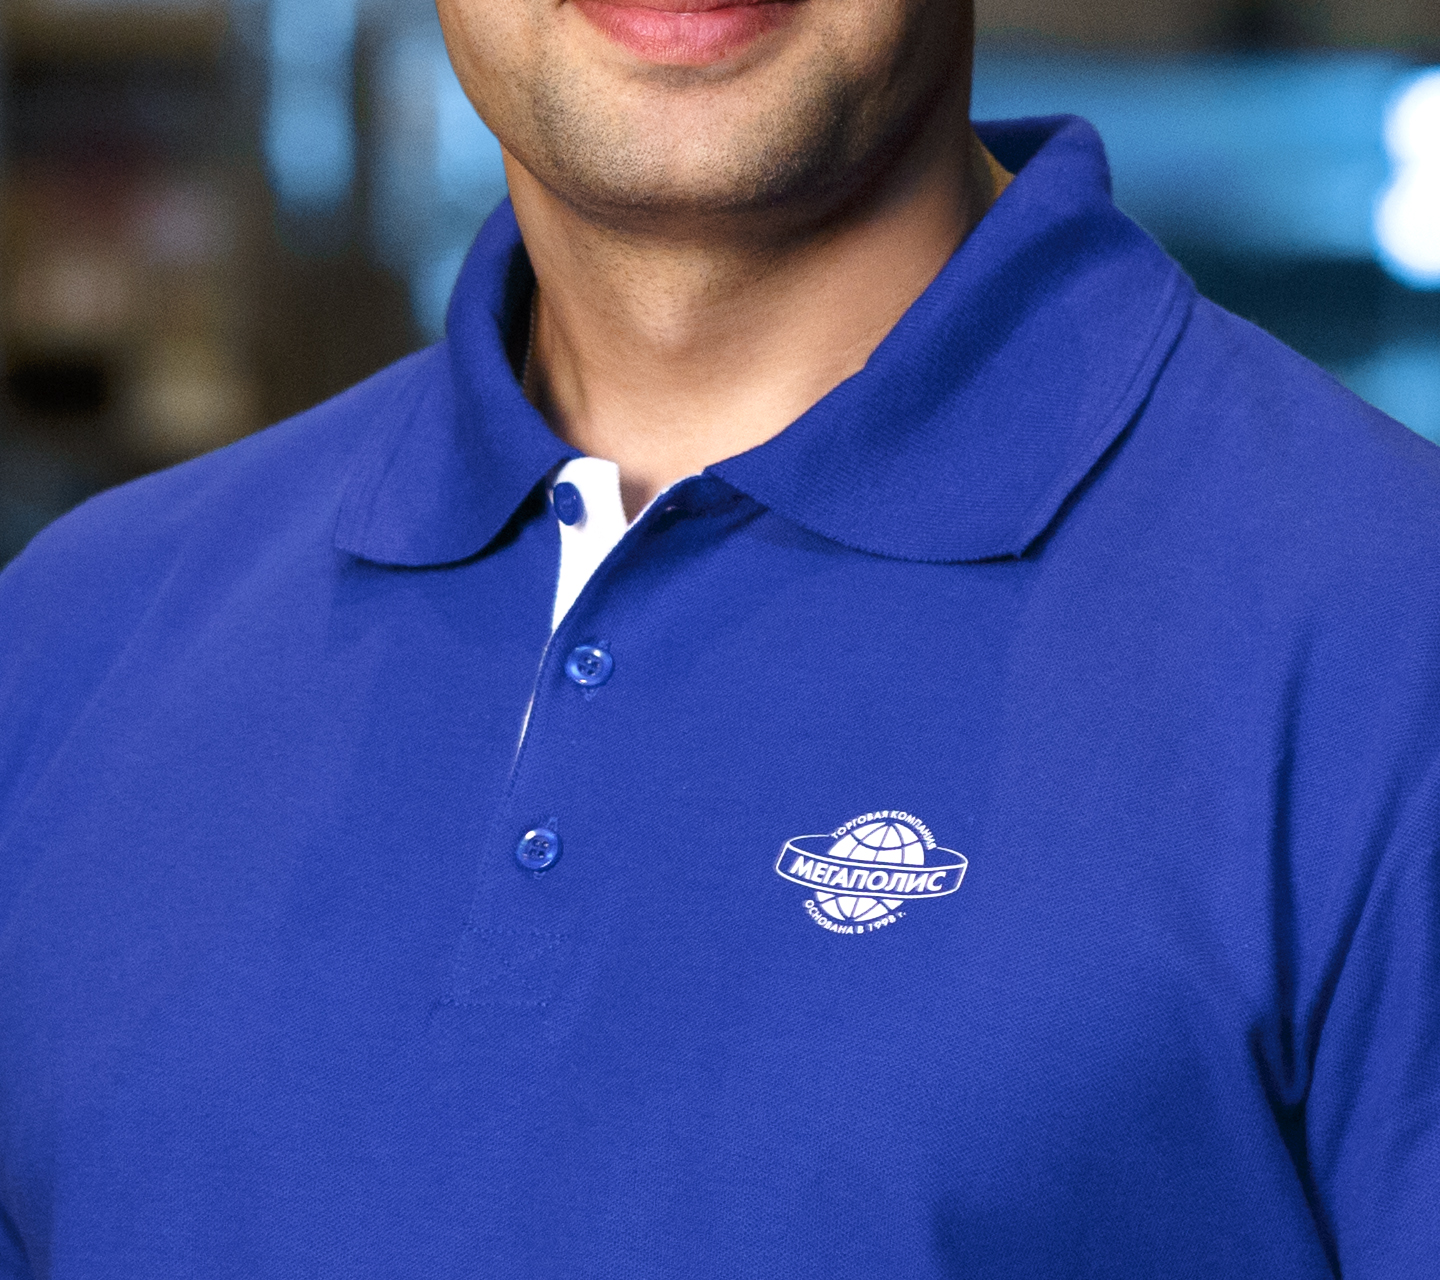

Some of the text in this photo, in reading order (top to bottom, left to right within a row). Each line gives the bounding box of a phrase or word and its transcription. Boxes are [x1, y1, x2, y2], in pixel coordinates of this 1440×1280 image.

[831, 810, 938, 850] ТОРГОВАЯ КОМПАНИЯ
[790, 855, 947, 893] МЕГАПОЛИС
[803, 899, 854, 935] ОСНОВАНА
[857, 924, 864, 934] В
[868, 915, 897, 933] 1998
